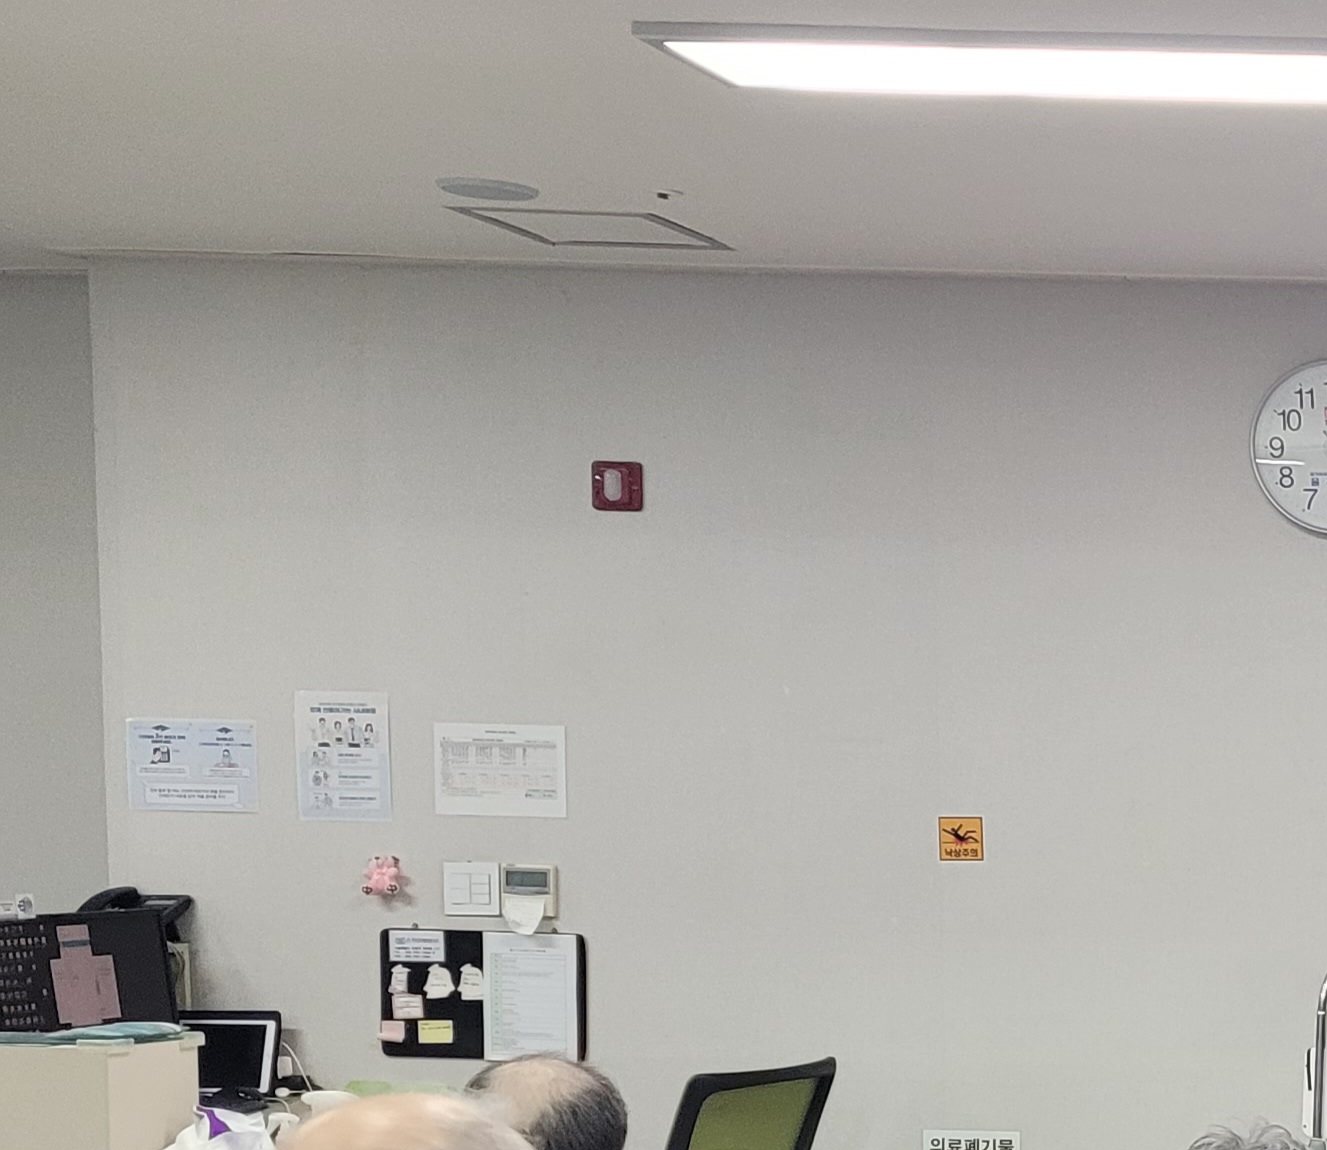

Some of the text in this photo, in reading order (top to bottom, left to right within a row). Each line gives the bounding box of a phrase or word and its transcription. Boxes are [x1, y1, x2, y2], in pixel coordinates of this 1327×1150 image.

[1294, 387, 1316, 409] 11
[1277, 409, 1302, 431] 10
[1269, 436, 1285, 459] 9
[1279, 466, 1294, 488] 8
[1303, 488, 1318, 510] 7
[944, 848, 978, 858] 낙상주의
